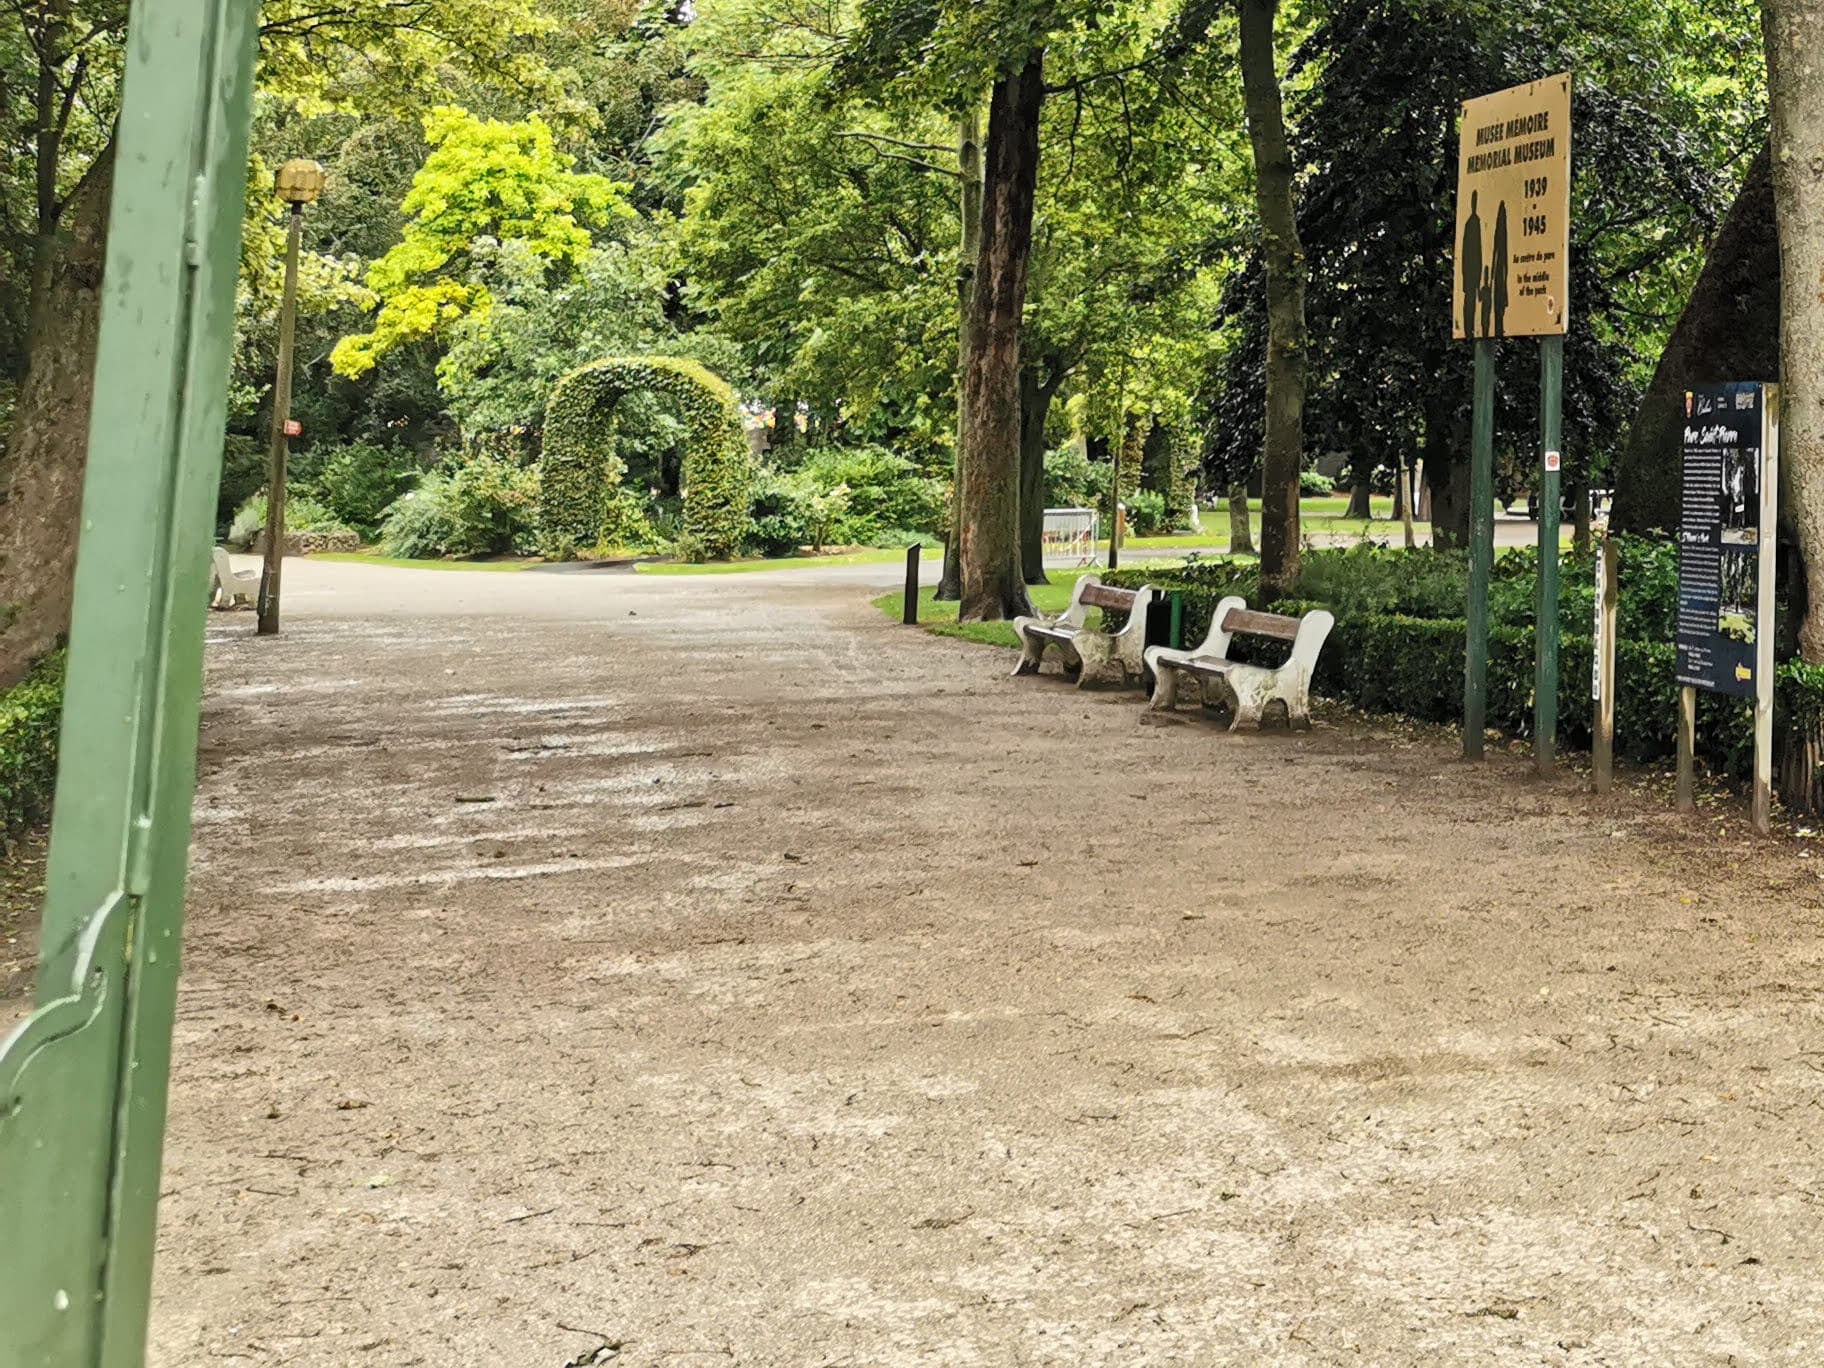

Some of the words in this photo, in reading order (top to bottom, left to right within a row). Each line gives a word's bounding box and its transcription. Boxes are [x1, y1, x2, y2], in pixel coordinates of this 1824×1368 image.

[1467, 147, 1511, 174] MEMORIAL
[1514, 137, 1554, 164] MUSEUM
[1524, 176, 1548, 199] 1939
[1523, 215, 1546, 237] 1945
